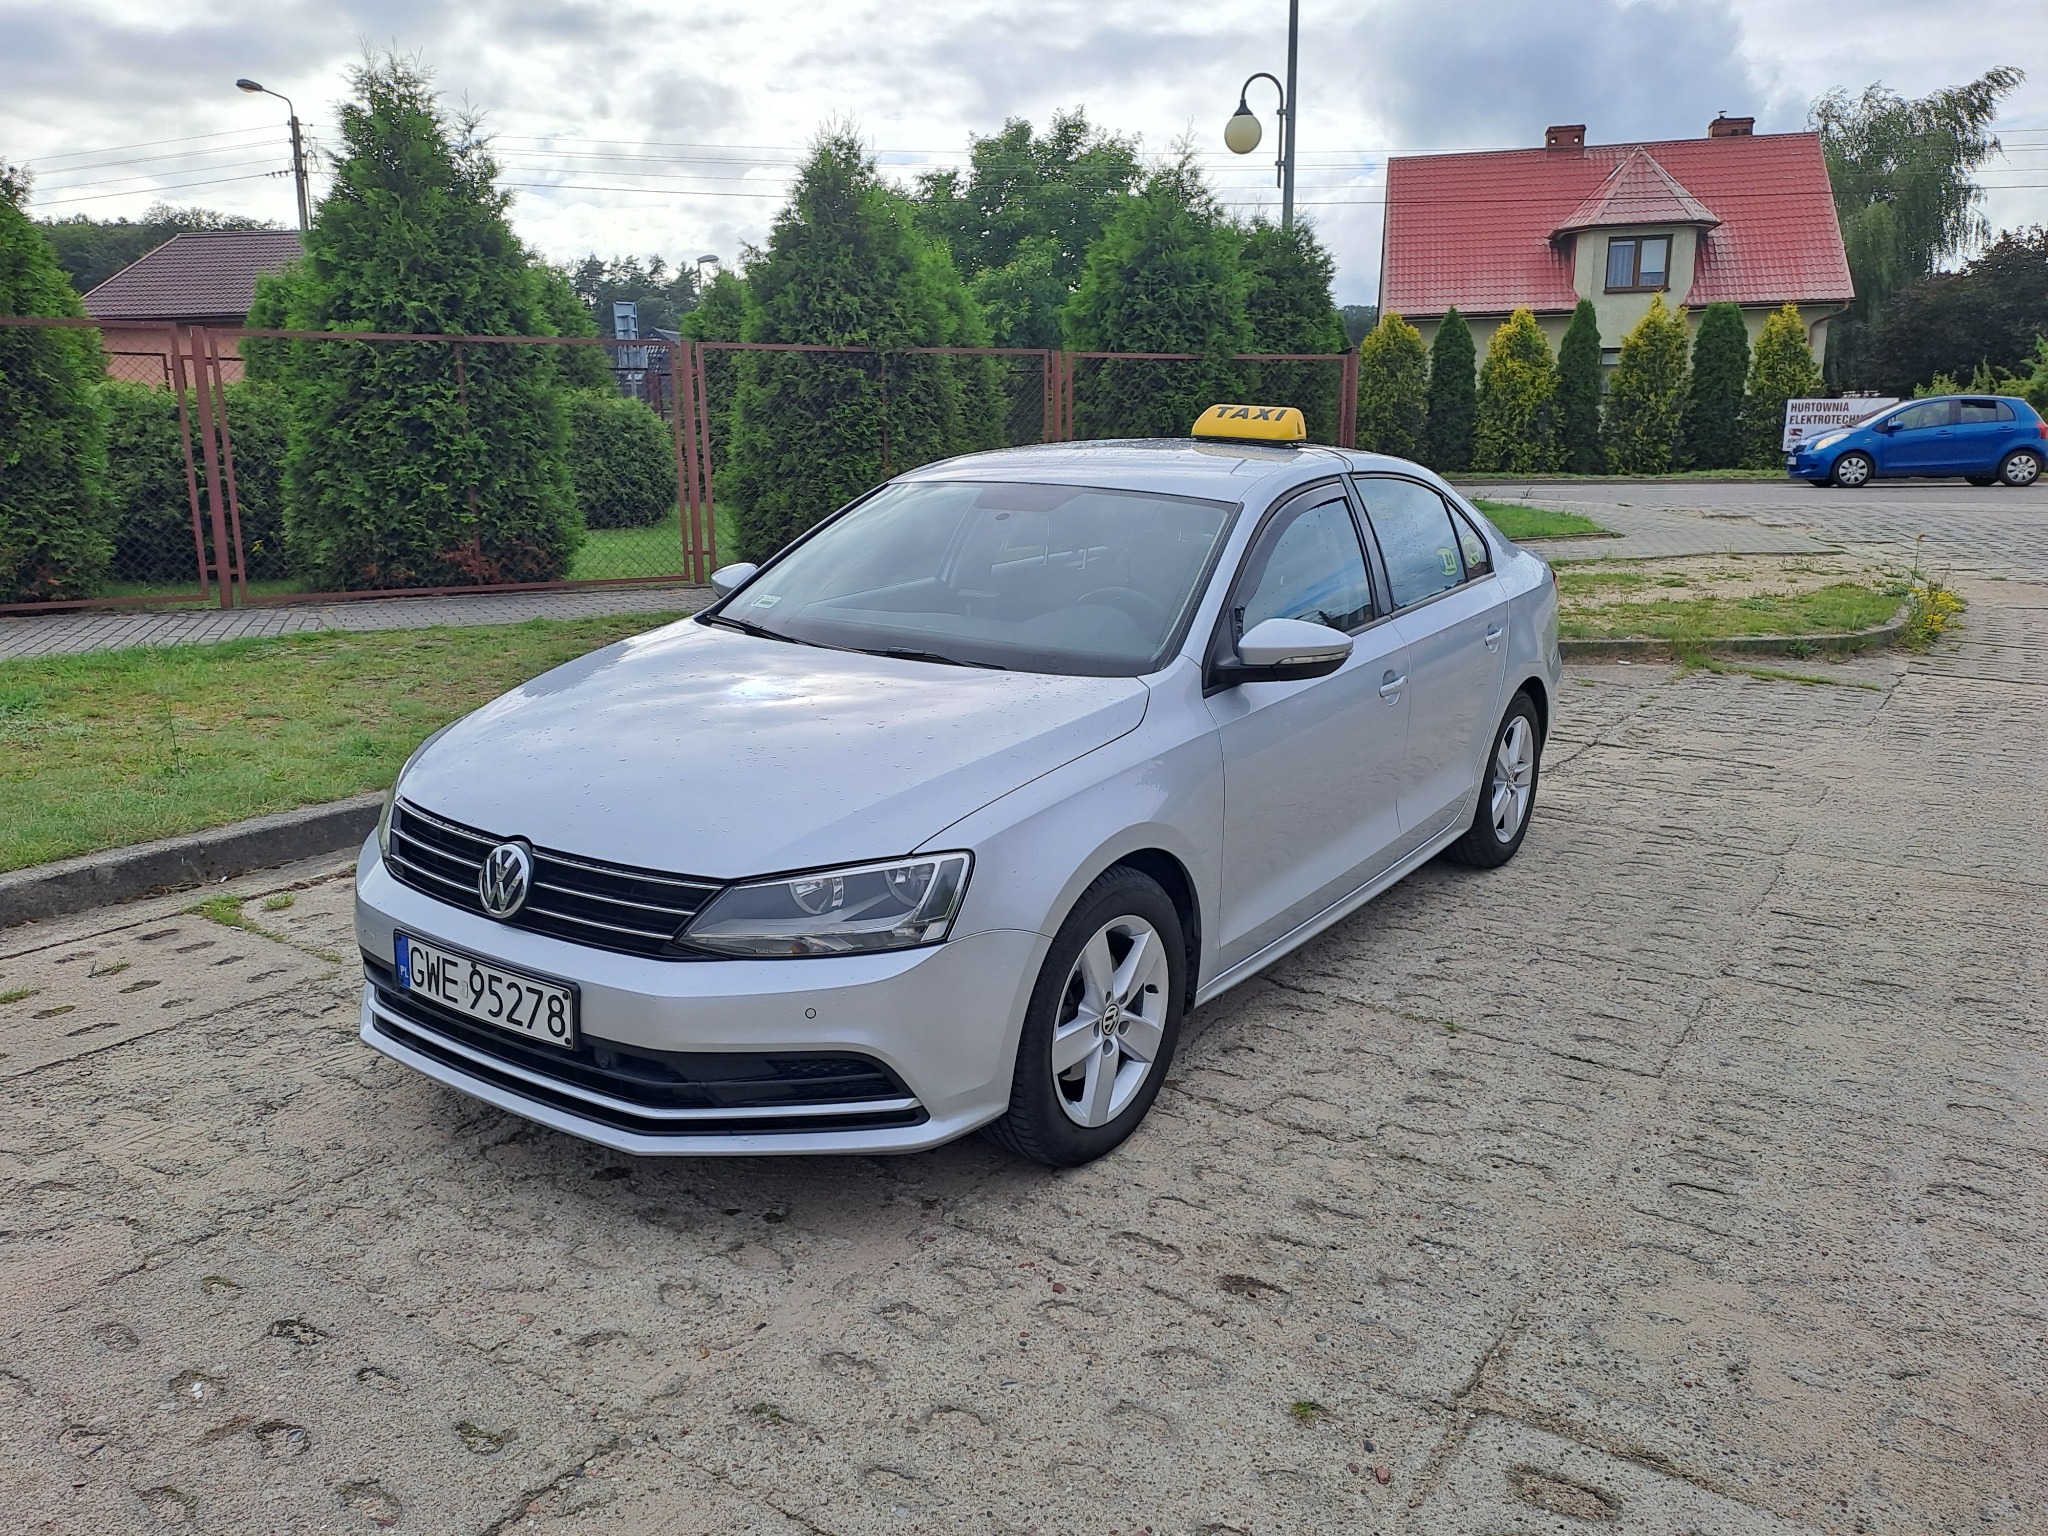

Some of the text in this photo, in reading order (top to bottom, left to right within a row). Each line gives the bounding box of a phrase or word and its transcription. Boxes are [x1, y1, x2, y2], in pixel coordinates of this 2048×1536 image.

[1216, 406, 1288, 421] TAXI
[1790, 402, 1850, 413] HURTOWNIA
[400, 964, 409, 979] PL
[410, 946, 566, 1038] GWE 95278
